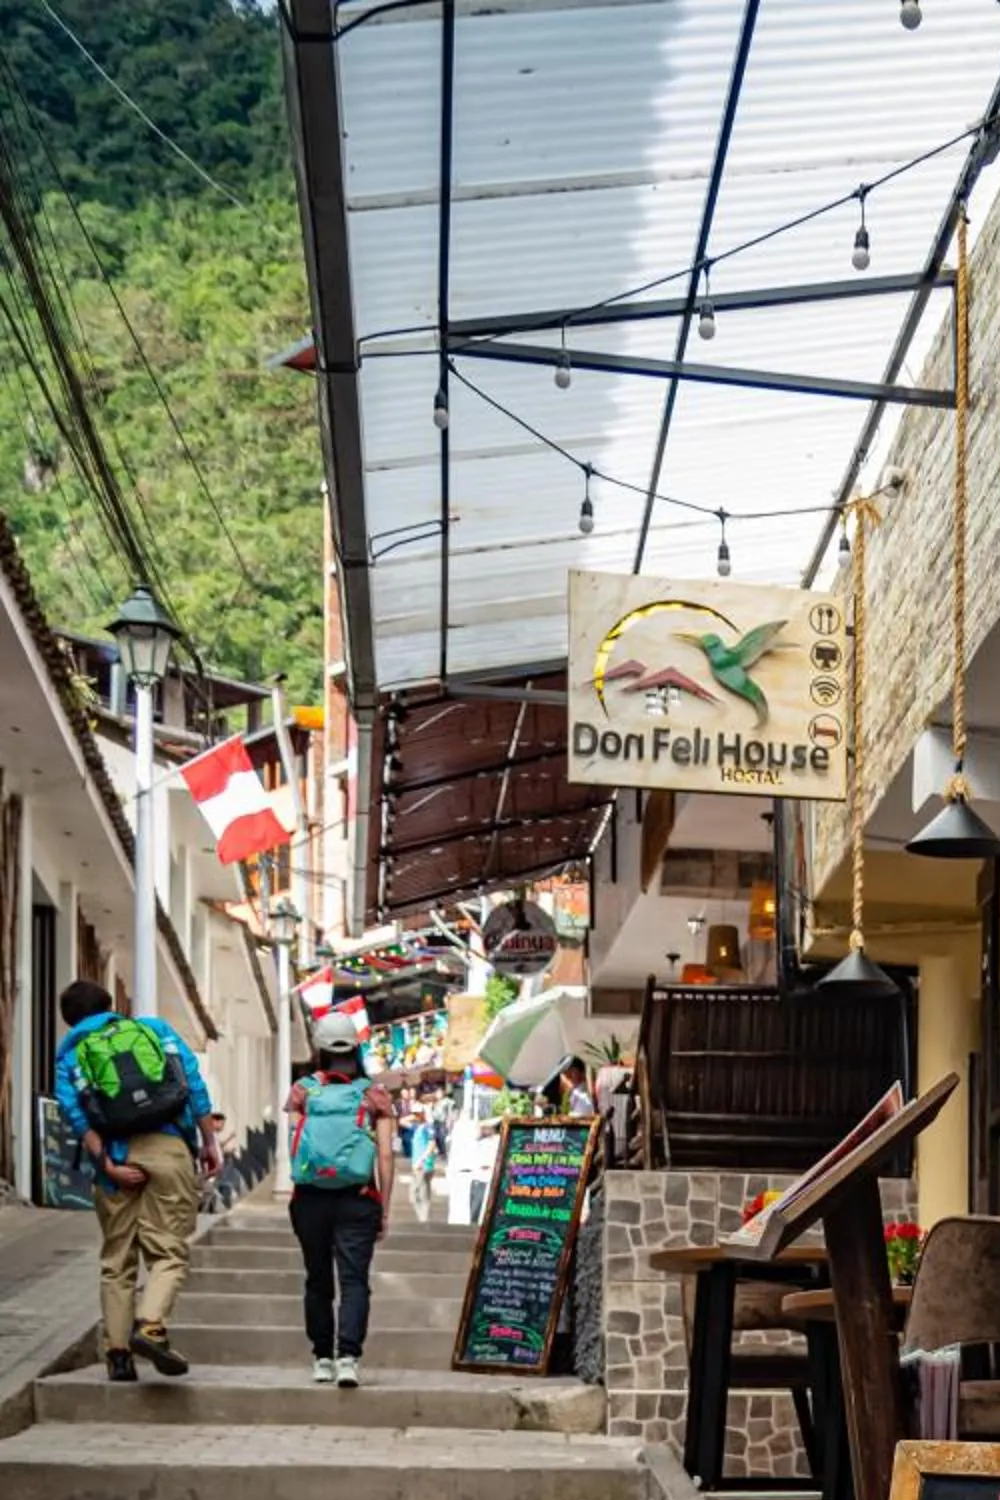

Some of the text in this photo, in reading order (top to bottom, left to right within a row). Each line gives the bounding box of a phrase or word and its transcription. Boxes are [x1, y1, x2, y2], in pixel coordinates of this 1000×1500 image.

[572, 722, 645, 762] Don
[716, 732, 830, 772] House
[721, 767, 784, 785] HOSTAL
